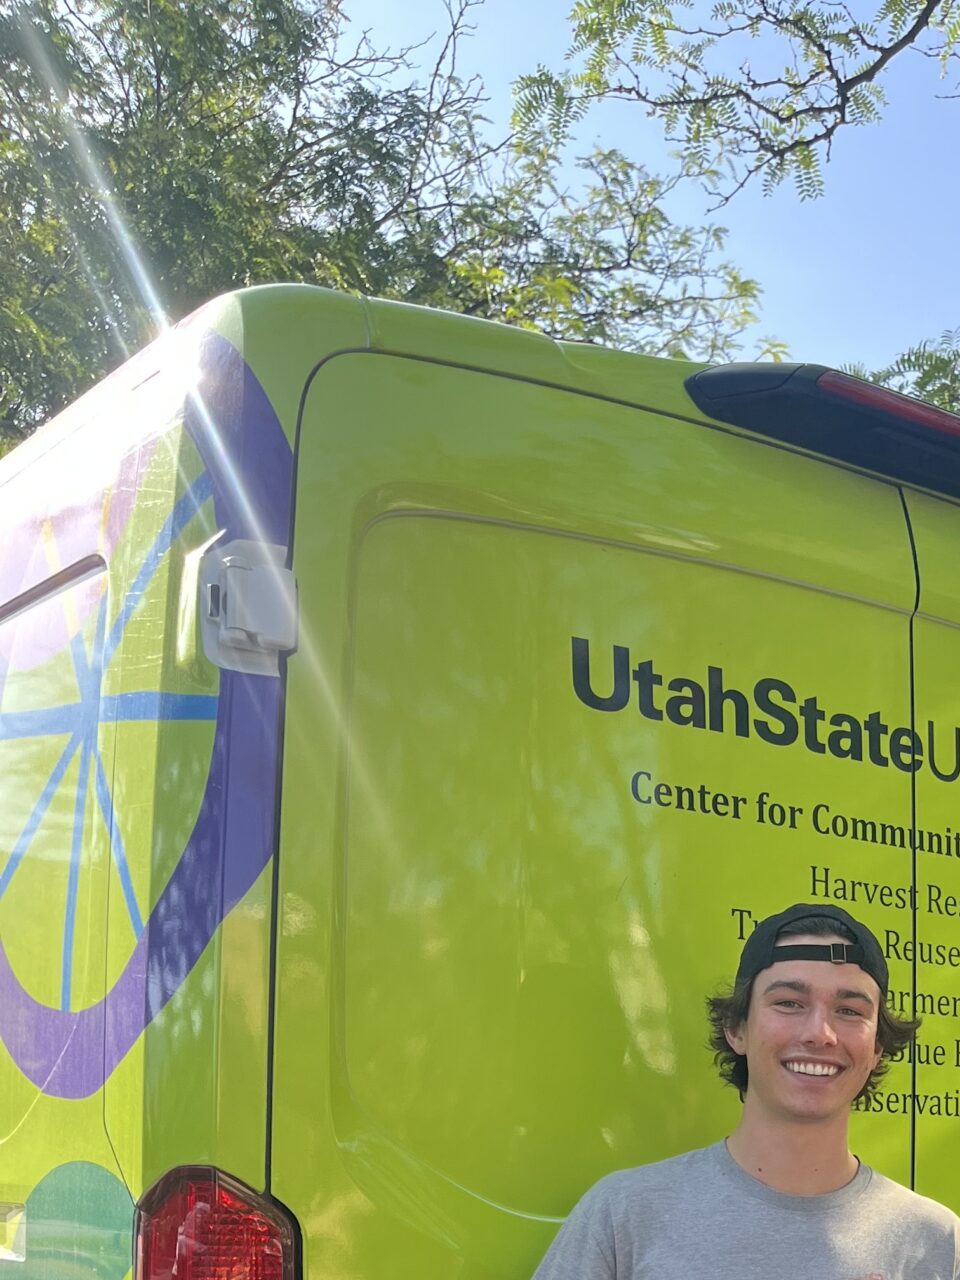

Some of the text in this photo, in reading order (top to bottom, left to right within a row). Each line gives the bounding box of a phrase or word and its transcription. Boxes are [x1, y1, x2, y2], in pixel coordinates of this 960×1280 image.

[631, 771, 747, 820] Center
[756, 792, 804, 830] for
[810, 866, 919, 911] Harvest
[885, 929, 960, 967] Reuse
